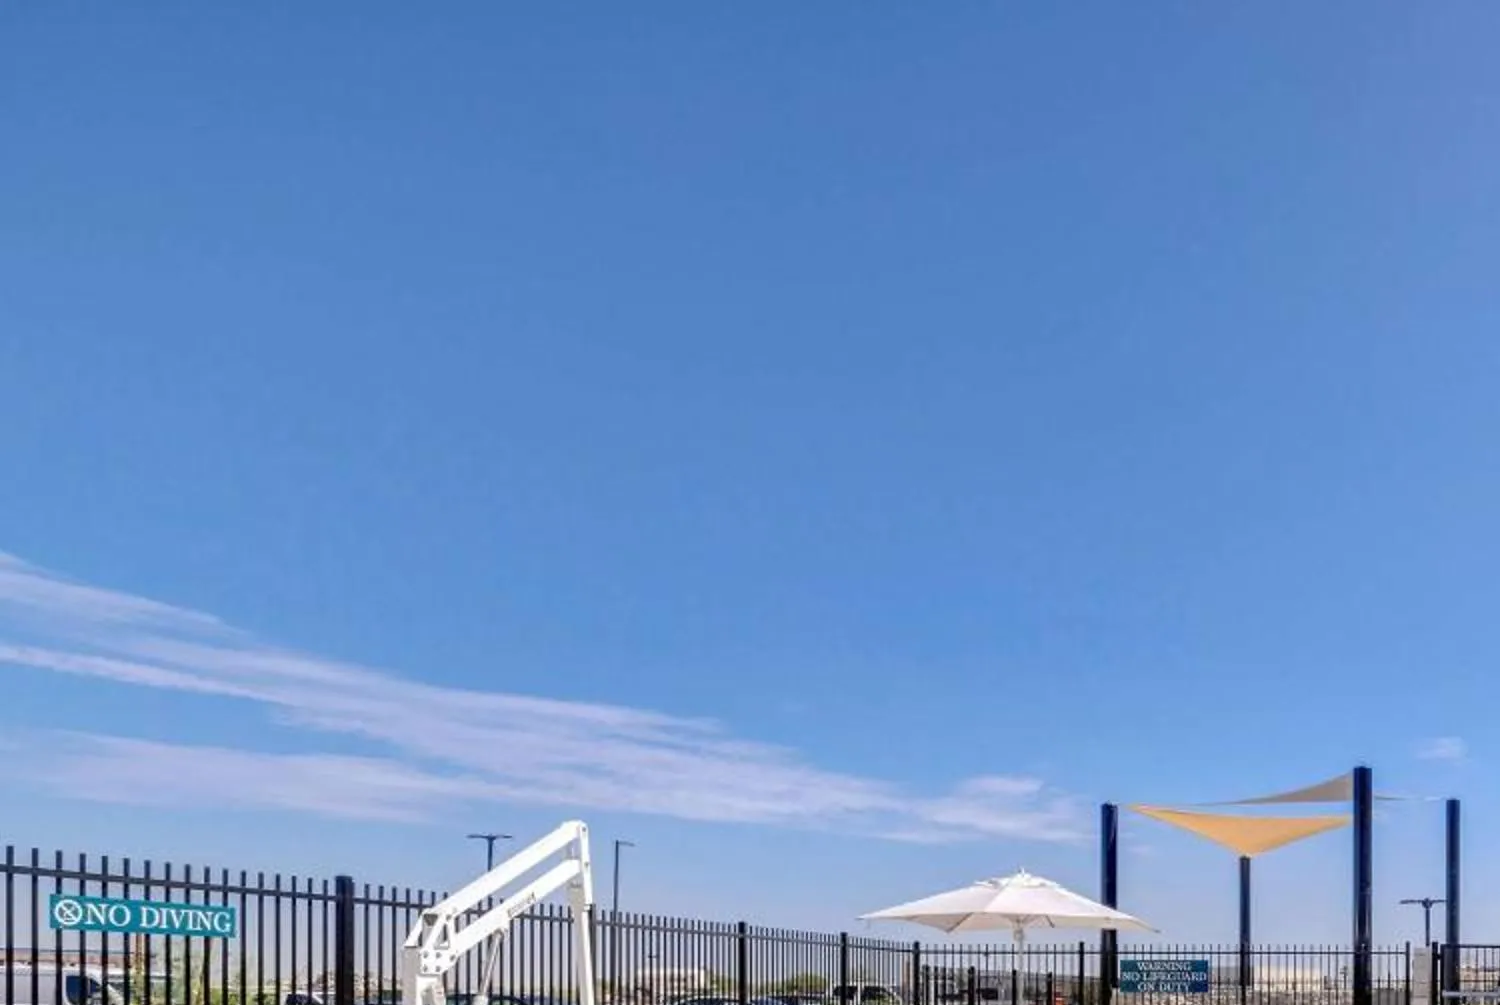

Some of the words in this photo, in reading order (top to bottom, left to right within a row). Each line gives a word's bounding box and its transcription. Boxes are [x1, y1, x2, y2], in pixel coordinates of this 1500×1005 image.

[84, 903, 131, 927] NO
[139, 906, 233, 933] DIVING
[1136, 961, 1192, 971] WARNING
[1121, 971, 1140, 981] NO
[1143, 971, 1207, 981] LIFEGUARD
[1137, 981, 1155, 991] ON
[1160, 981, 1191, 992] DUTY
